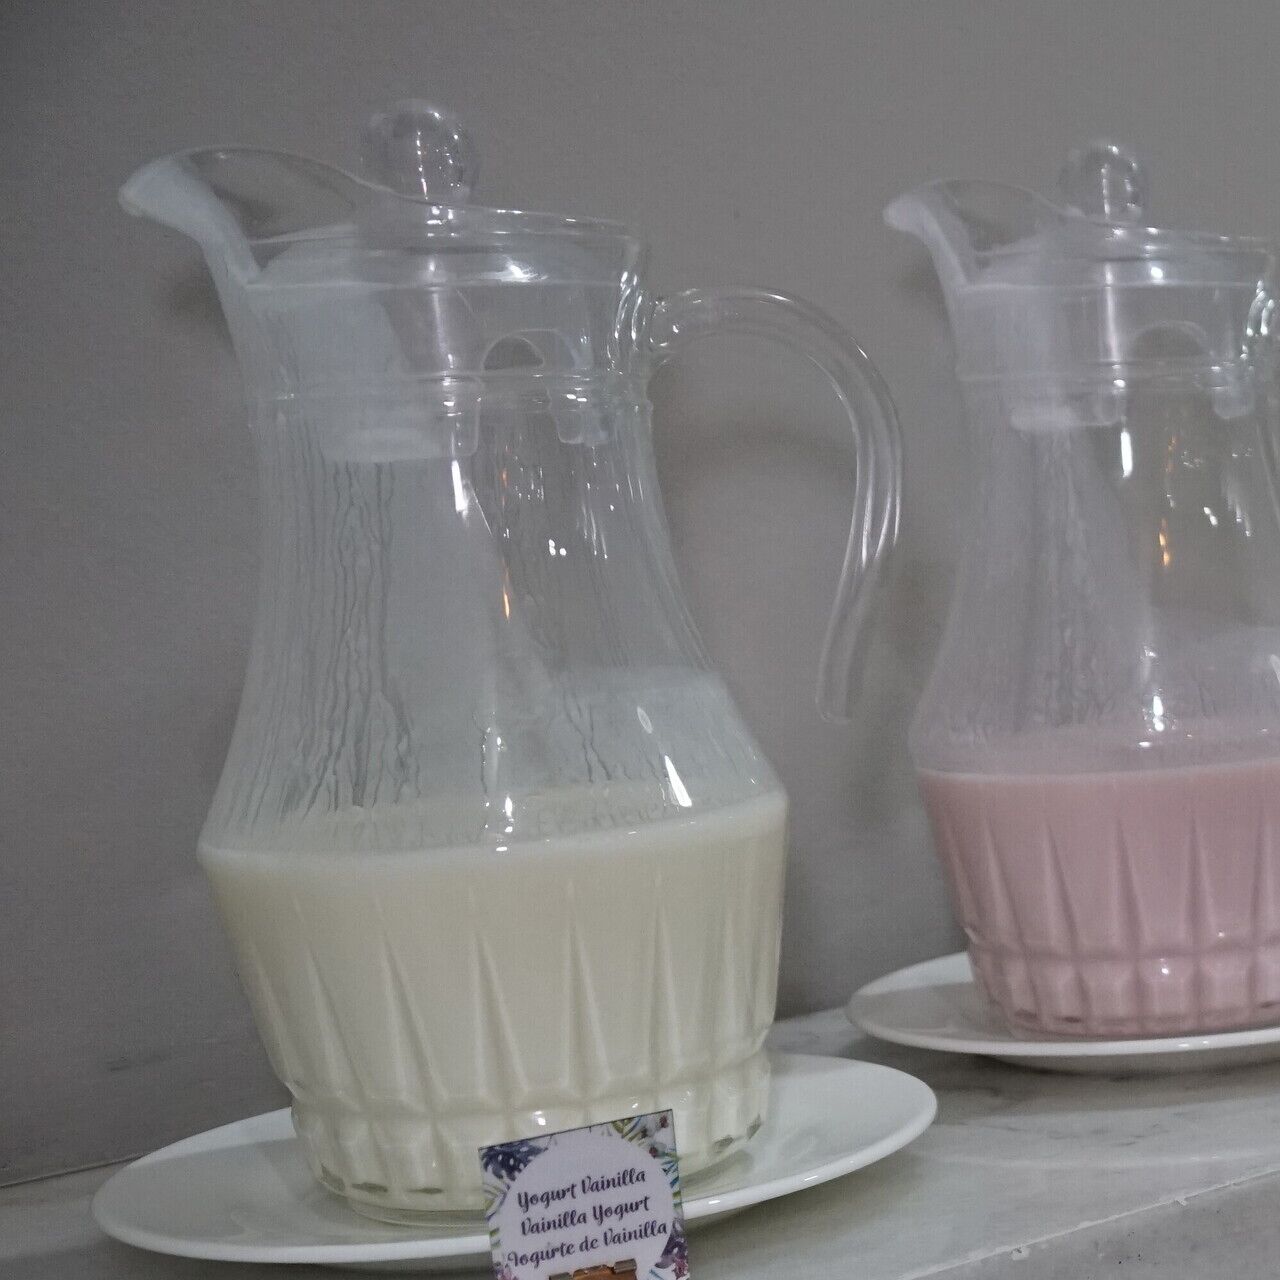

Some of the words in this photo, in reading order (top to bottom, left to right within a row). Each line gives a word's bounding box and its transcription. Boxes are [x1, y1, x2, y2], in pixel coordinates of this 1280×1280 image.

[518, 1183, 578, 1213] Yogurt
[581, 1167, 646, 1195] Vainilla
[521, 1210, 587, 1237] Vainilla
[592, 1195, 651, 1225] Yogurt
[505, 1241, 575, 1269] Iogurte
[579, 1235, 600, 1252] de
[603, 1219, 668, 1244] Vainilla
